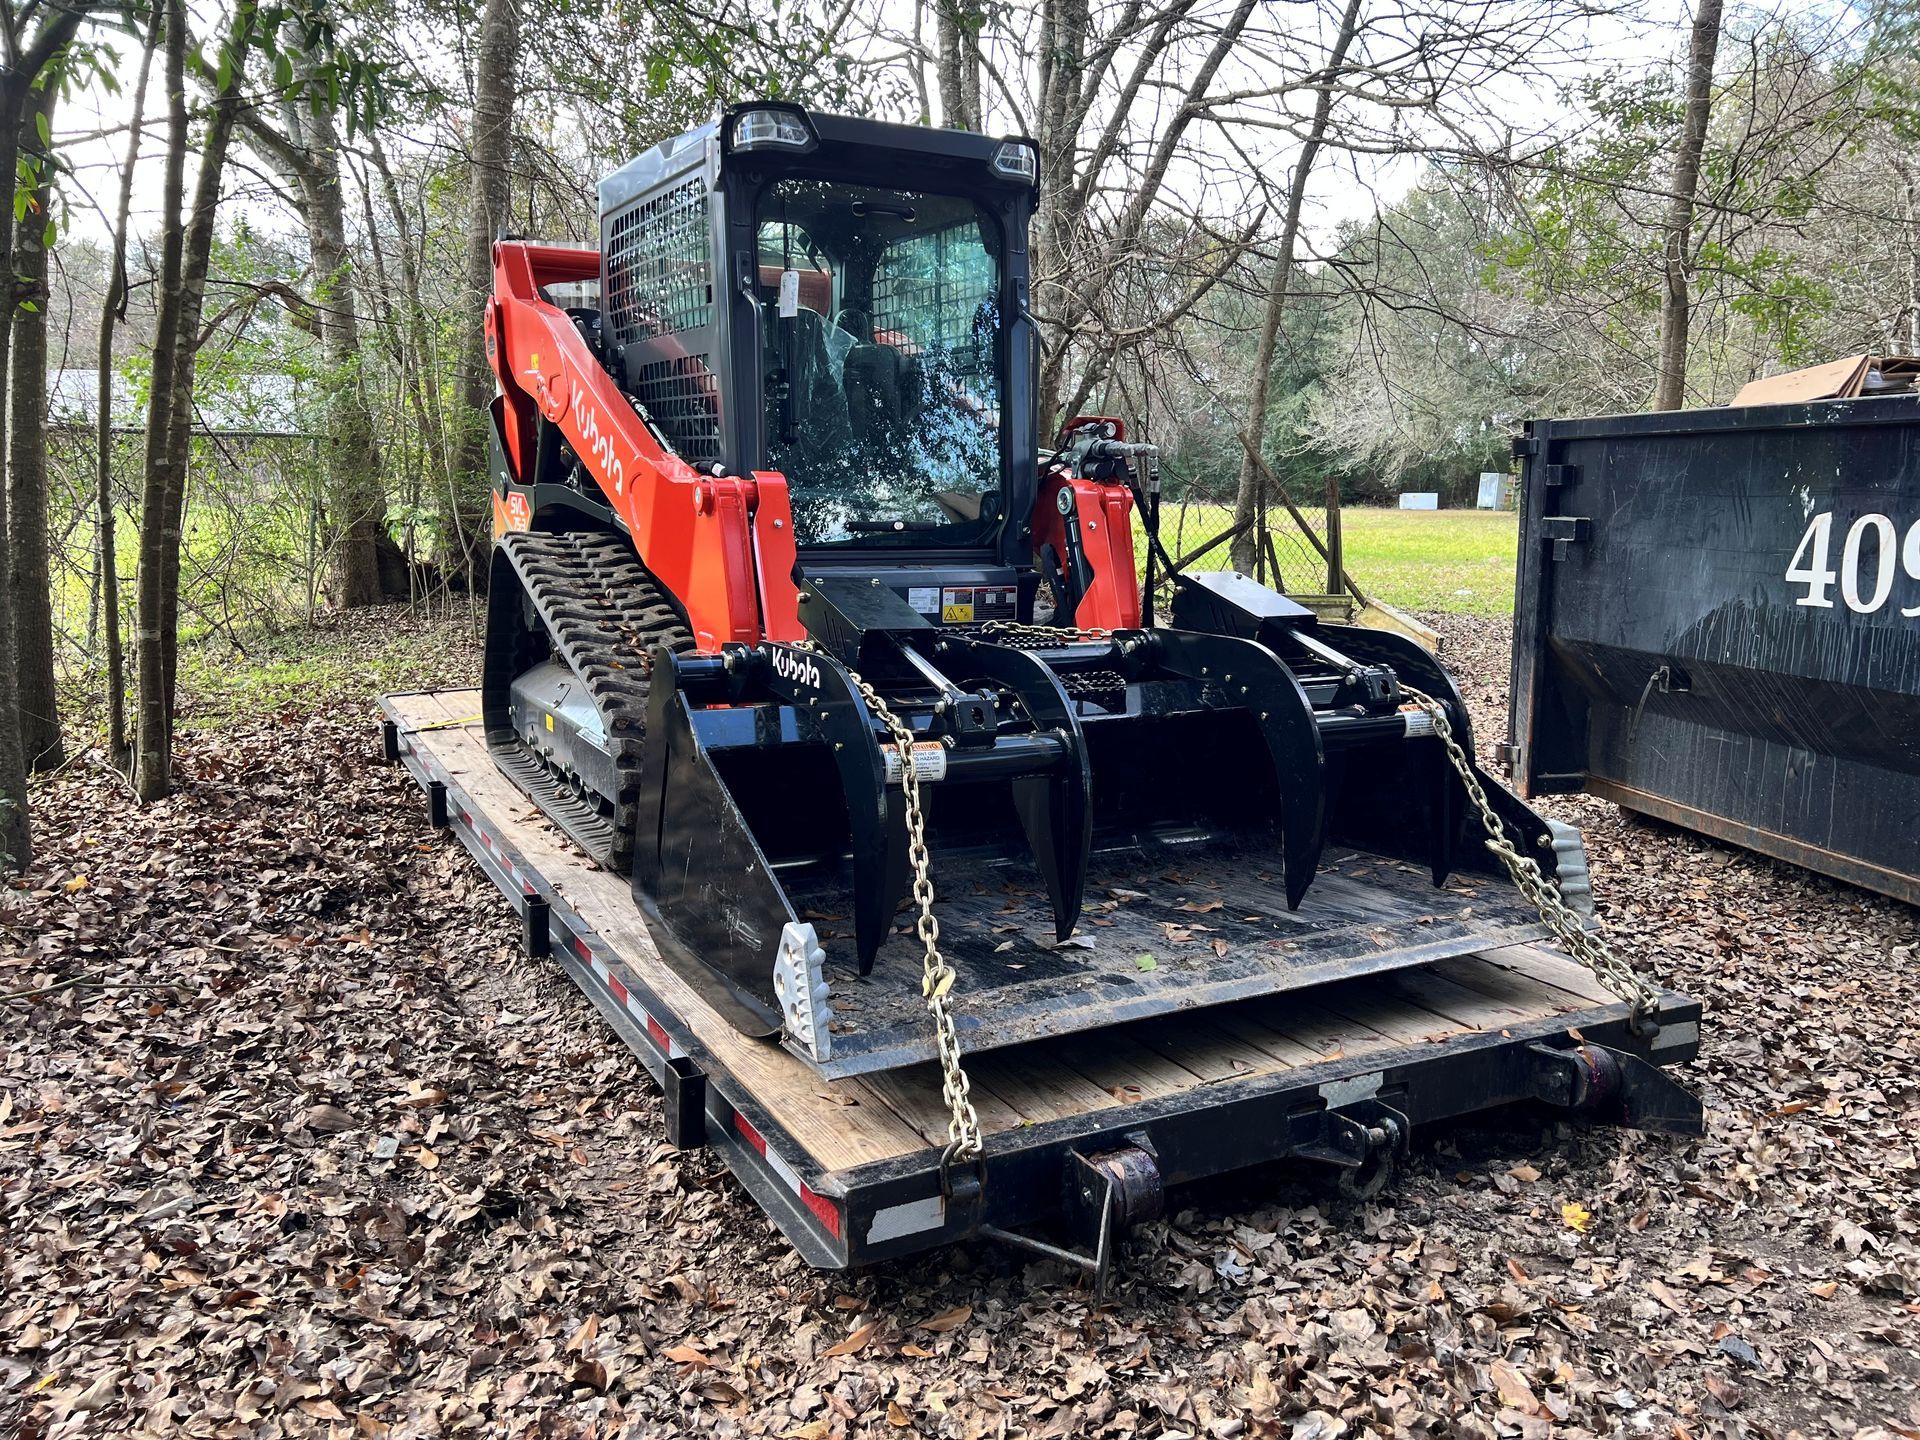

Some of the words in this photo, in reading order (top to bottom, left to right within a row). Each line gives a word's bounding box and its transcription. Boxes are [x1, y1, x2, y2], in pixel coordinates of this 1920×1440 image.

[571, 379, 623, 497] Kubota
[510, 495, 525, 516] SVL
[772, 646, 820, 689] Kubota
